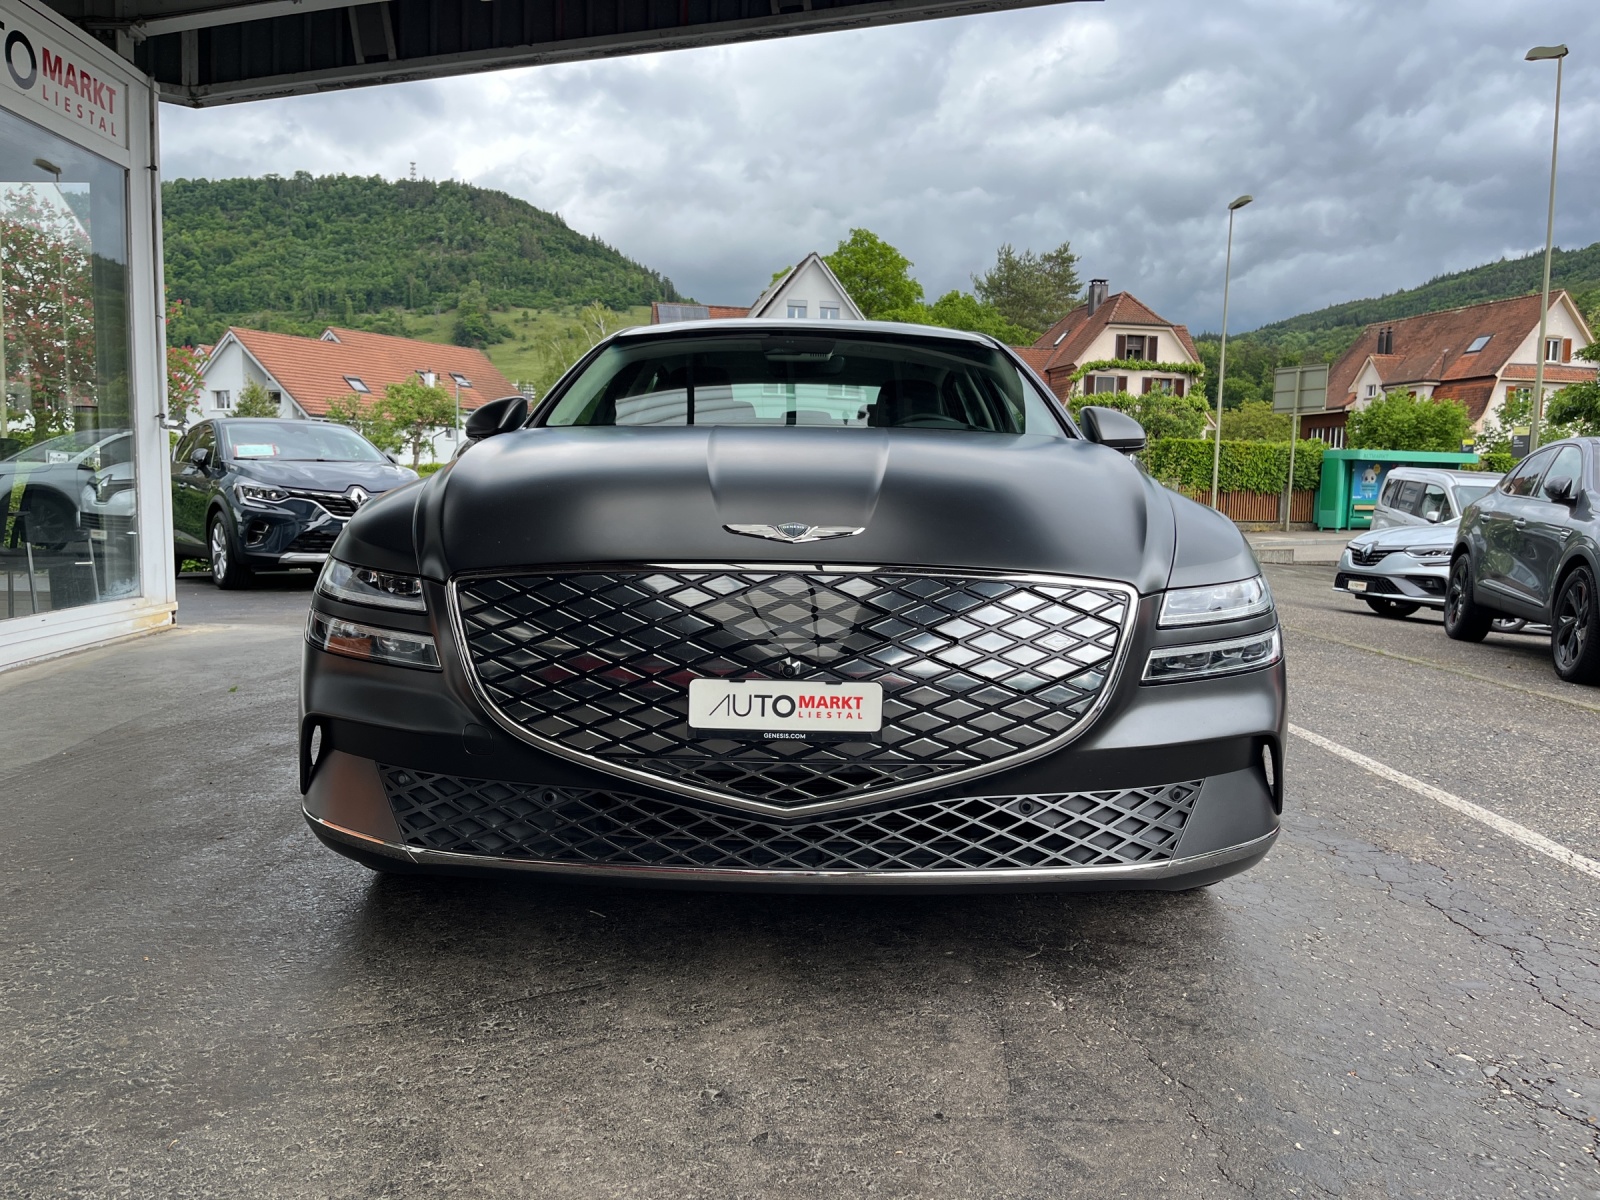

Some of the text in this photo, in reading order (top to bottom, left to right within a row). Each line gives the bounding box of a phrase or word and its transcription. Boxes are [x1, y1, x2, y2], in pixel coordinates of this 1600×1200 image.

[0, 20, 117, 115] O MARKT
[42, 84, 117, 137] LIESTAL
[709, 694, 863, 718] AUTO MARKT
[798, 711, 863, 719] LIESTAL
